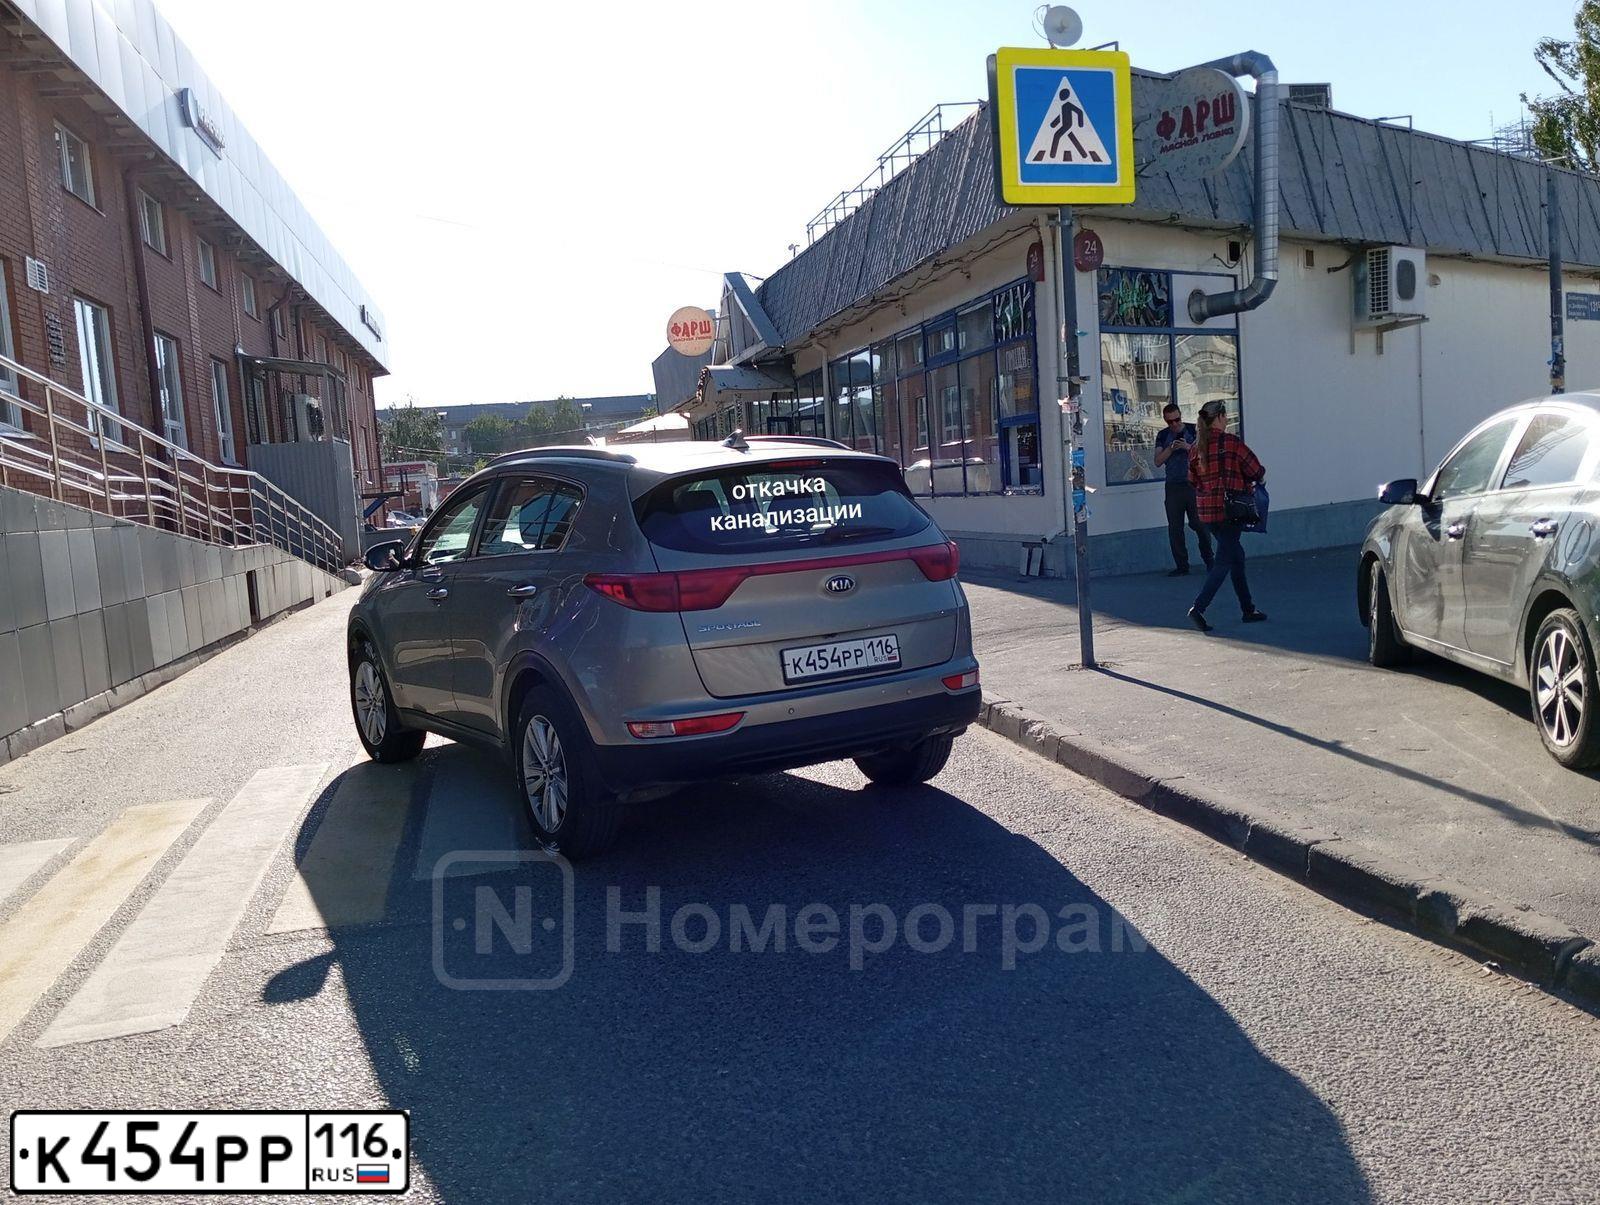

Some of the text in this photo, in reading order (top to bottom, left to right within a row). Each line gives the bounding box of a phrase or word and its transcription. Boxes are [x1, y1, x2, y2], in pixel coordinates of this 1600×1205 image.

[1156, 92, 1235, 141] ФАРШ
[1084, 240, 1097, 254] 24
[671, 320, 711, 337] ФАРШ
[732, 477, 826, 500] откачка
[710, 503, 863, 532] канализации
[831, 579, 851, 591] KIA
[791, 638, 893, 675] К454РР 116
[873, 655, 887, 663] RUS
